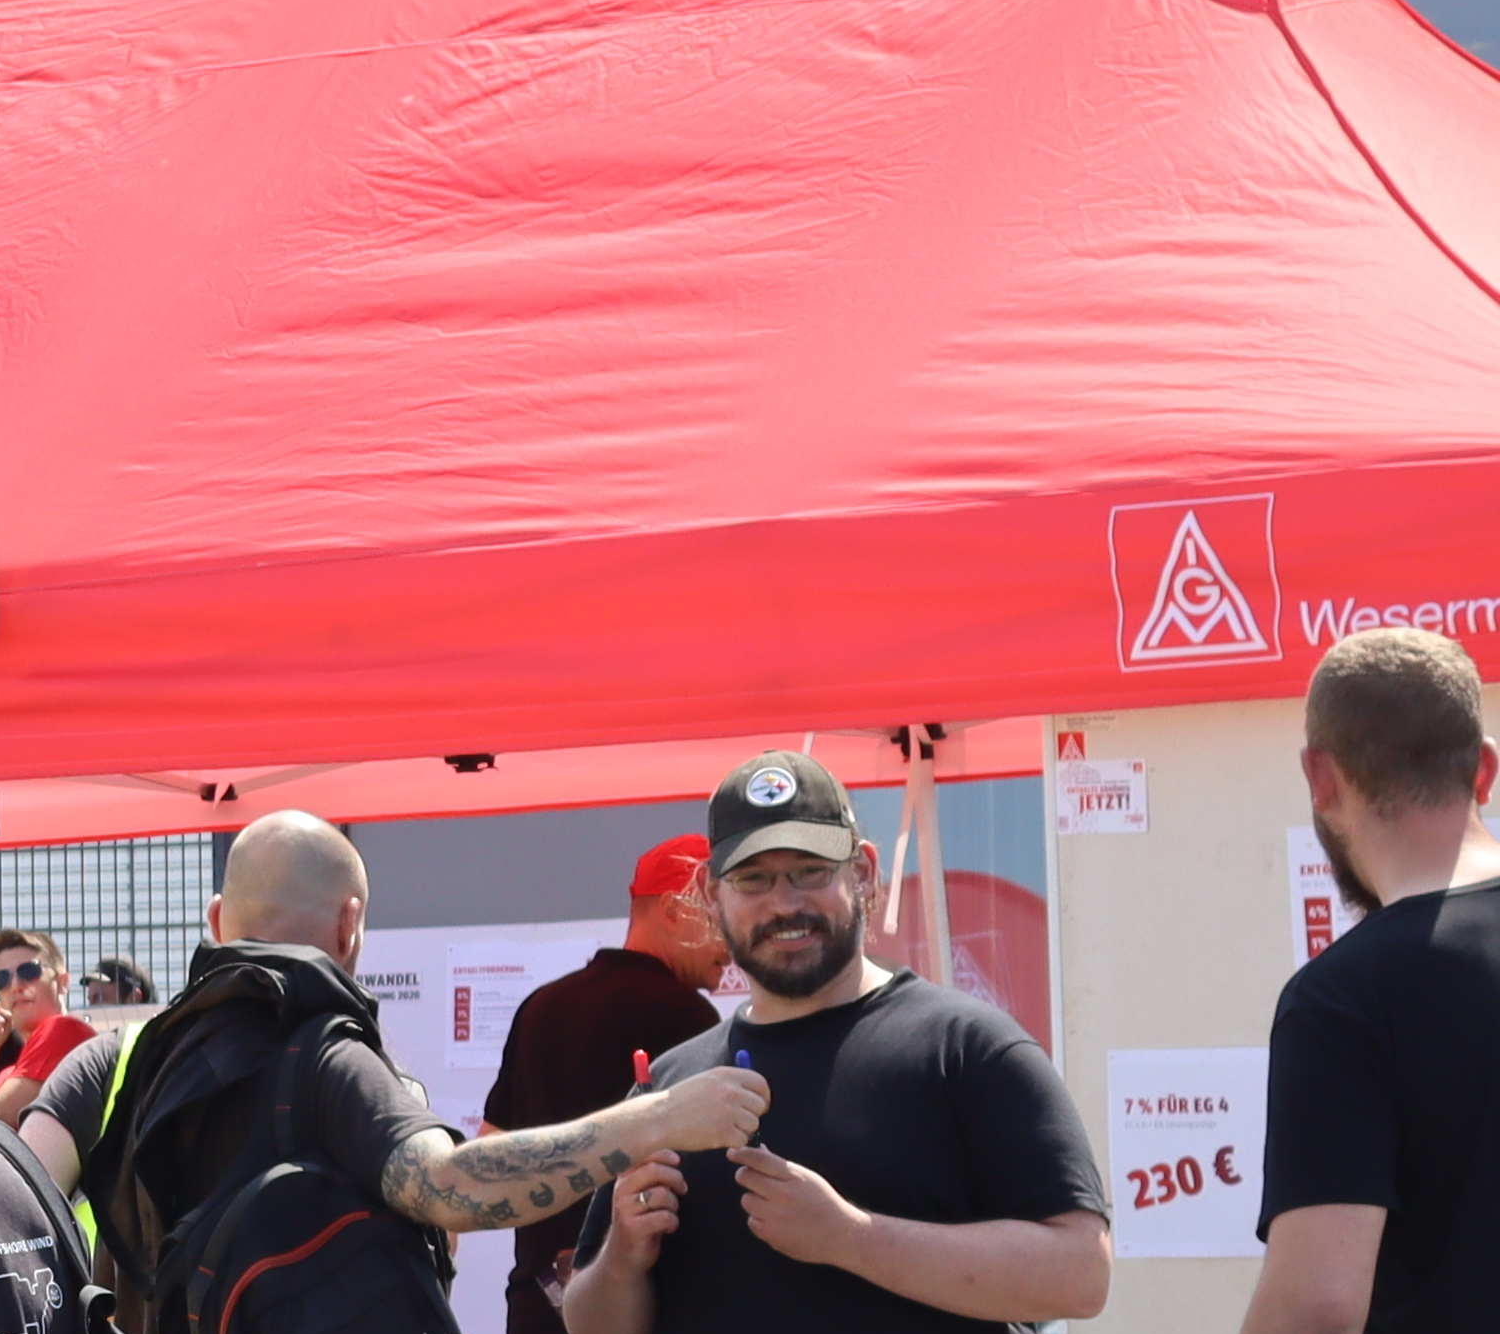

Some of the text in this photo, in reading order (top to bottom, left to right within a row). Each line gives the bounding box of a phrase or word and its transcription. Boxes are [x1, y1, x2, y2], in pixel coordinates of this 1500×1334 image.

[1079, 793, 1130, 815] JETZT!
[398, 990, 421, 1000] 2020
[1125, 1093, 1229, 1115] 7 % FÜR EG 4
[1127, 1145, 1243, 1210] 230 €
[28, 1235, 54, 1252] WIND
